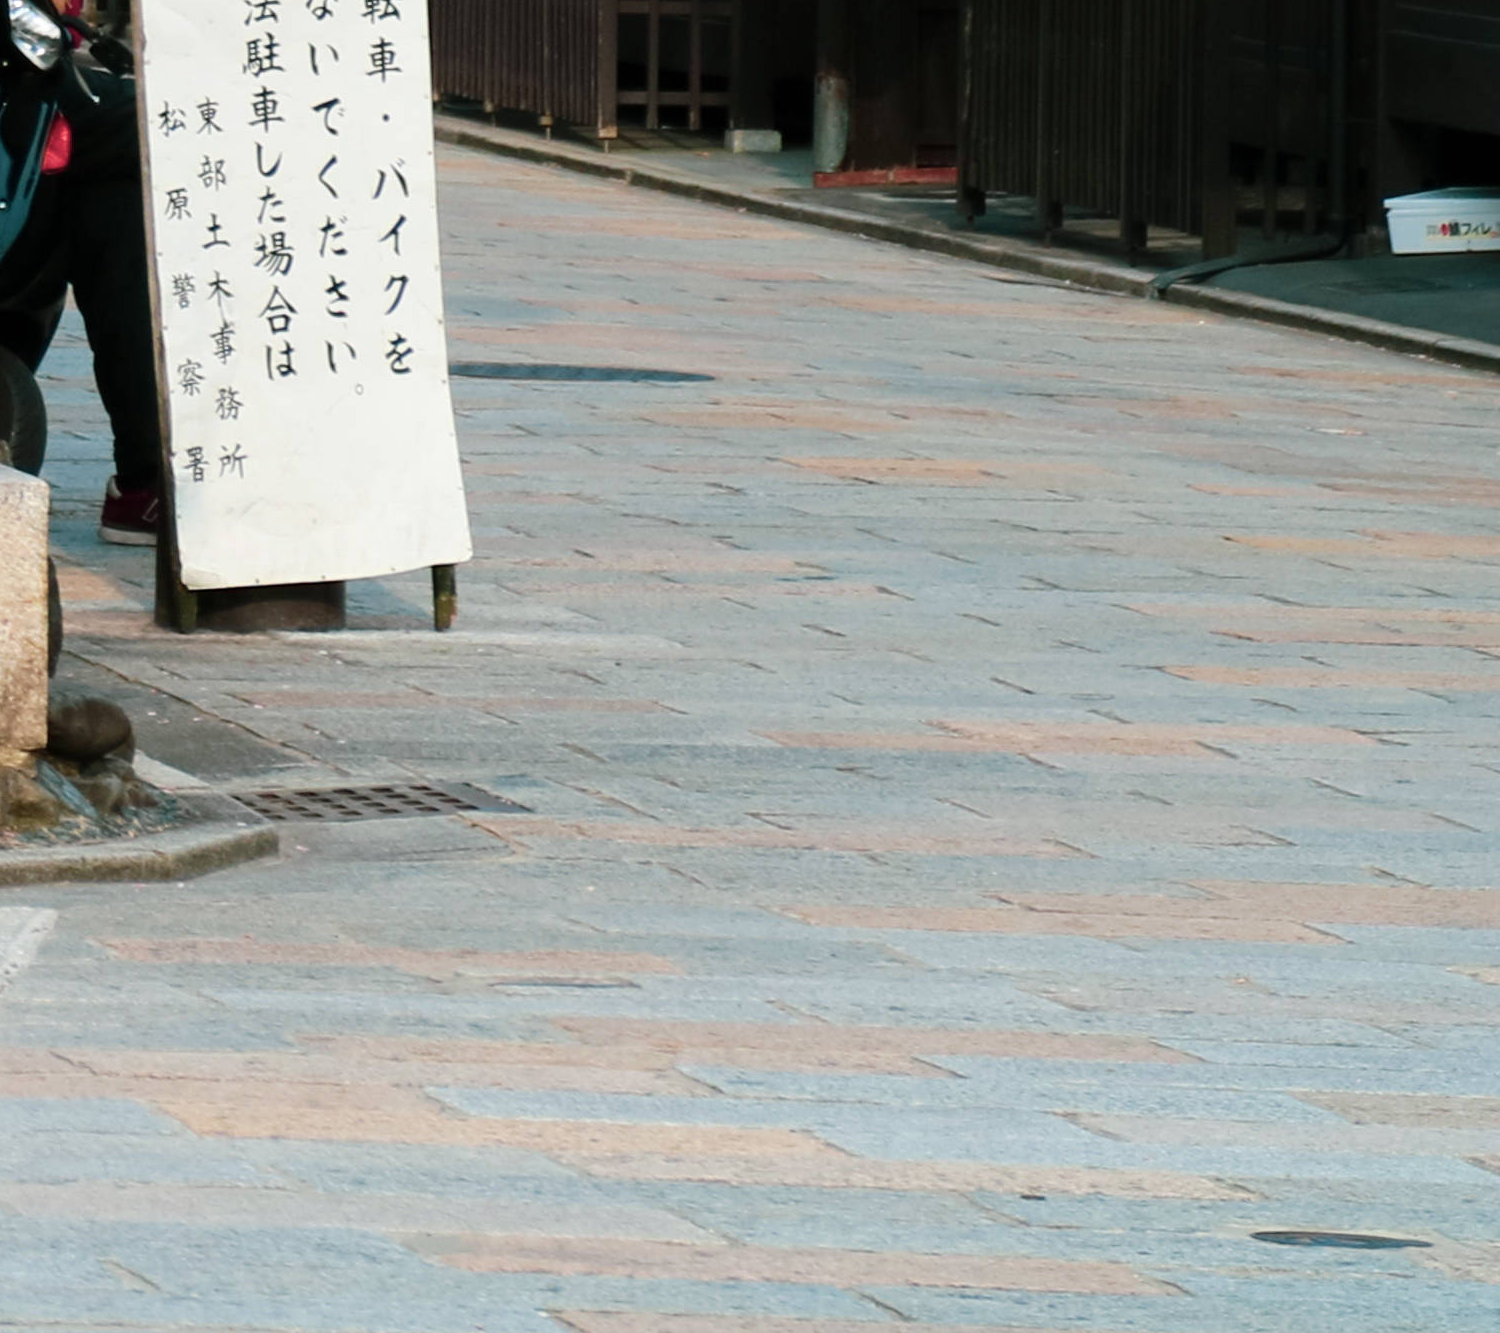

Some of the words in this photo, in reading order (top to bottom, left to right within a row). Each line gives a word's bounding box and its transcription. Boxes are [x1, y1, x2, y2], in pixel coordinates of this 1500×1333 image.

[158, 100, 210, 483] 松原警察署
[194, 97, 248, 479] 東部土木事務所
